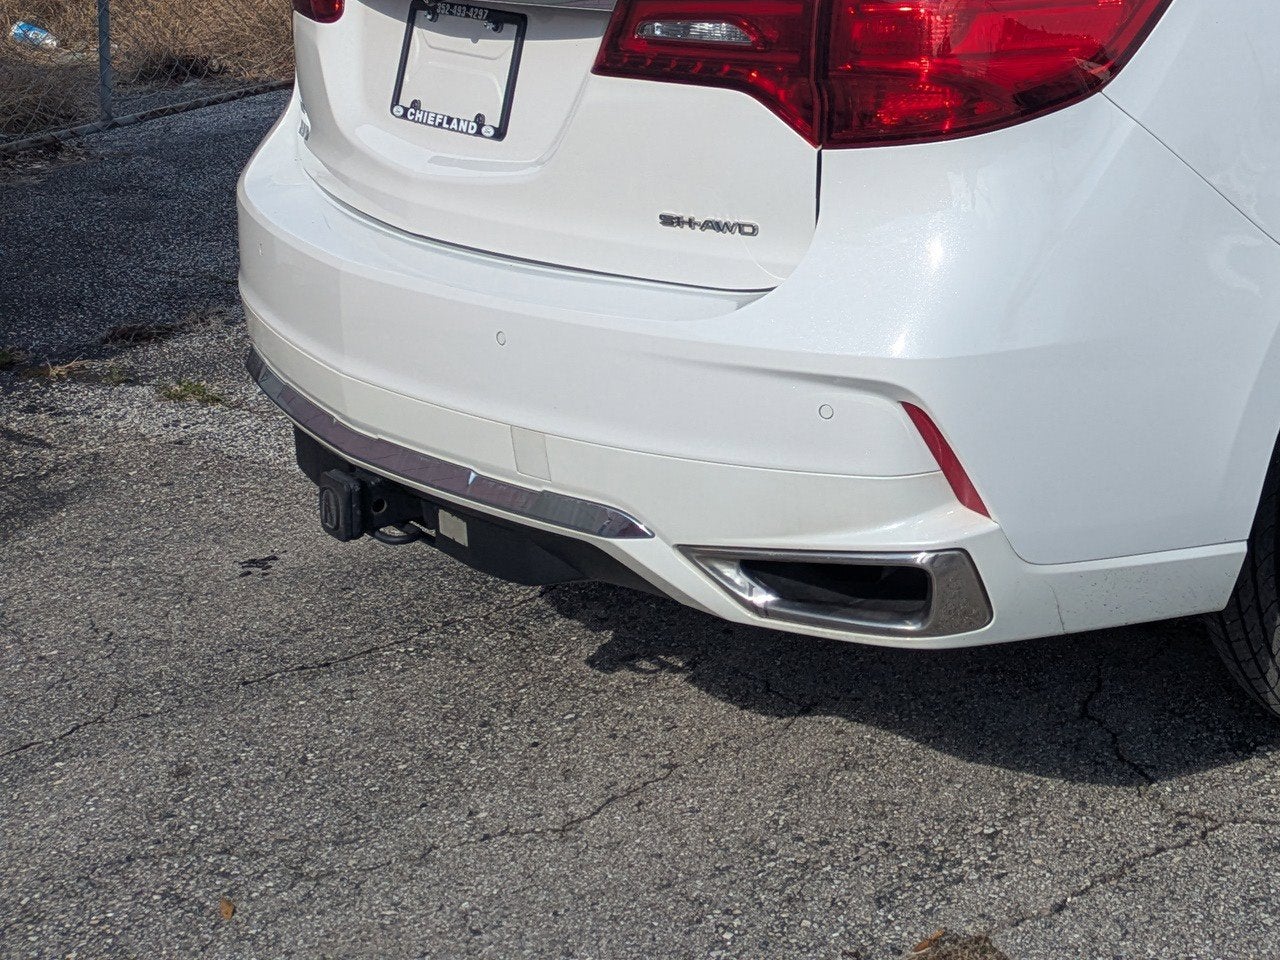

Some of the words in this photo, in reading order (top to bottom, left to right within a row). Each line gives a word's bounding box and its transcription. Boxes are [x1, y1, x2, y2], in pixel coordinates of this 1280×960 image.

[436, 3, 489, 20] 352-493-4297
[407, 108, 478, 135] CHIEFLAND
[658, 213, 760, 237] SH-AWD
